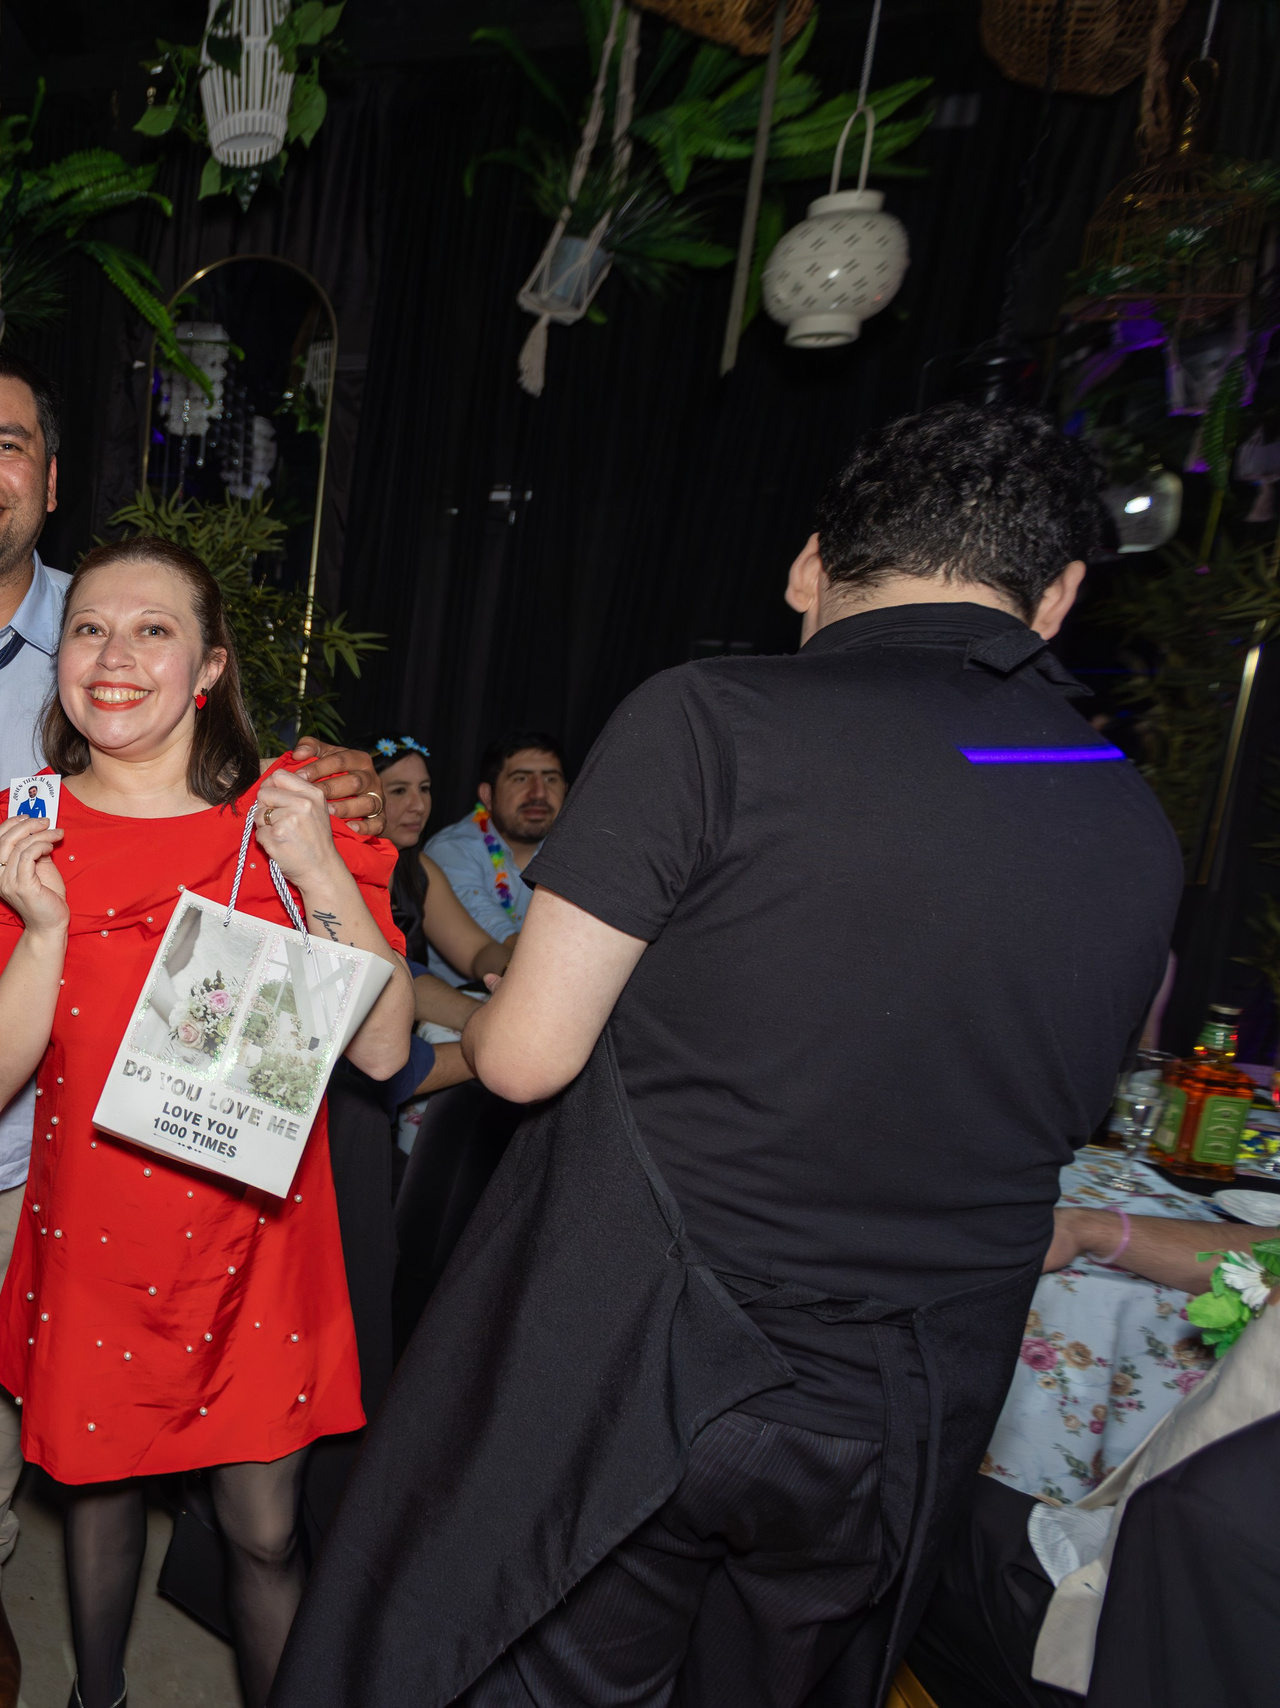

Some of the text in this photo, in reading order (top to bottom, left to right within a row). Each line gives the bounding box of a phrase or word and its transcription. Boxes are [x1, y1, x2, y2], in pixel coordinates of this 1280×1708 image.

[122, 1059, 301, 1141] DO YOU LOVE ME
[162, 1101, 239, 1140] LOVE YOU
[153, 1117, 238, 1158] 1000 TIMES
